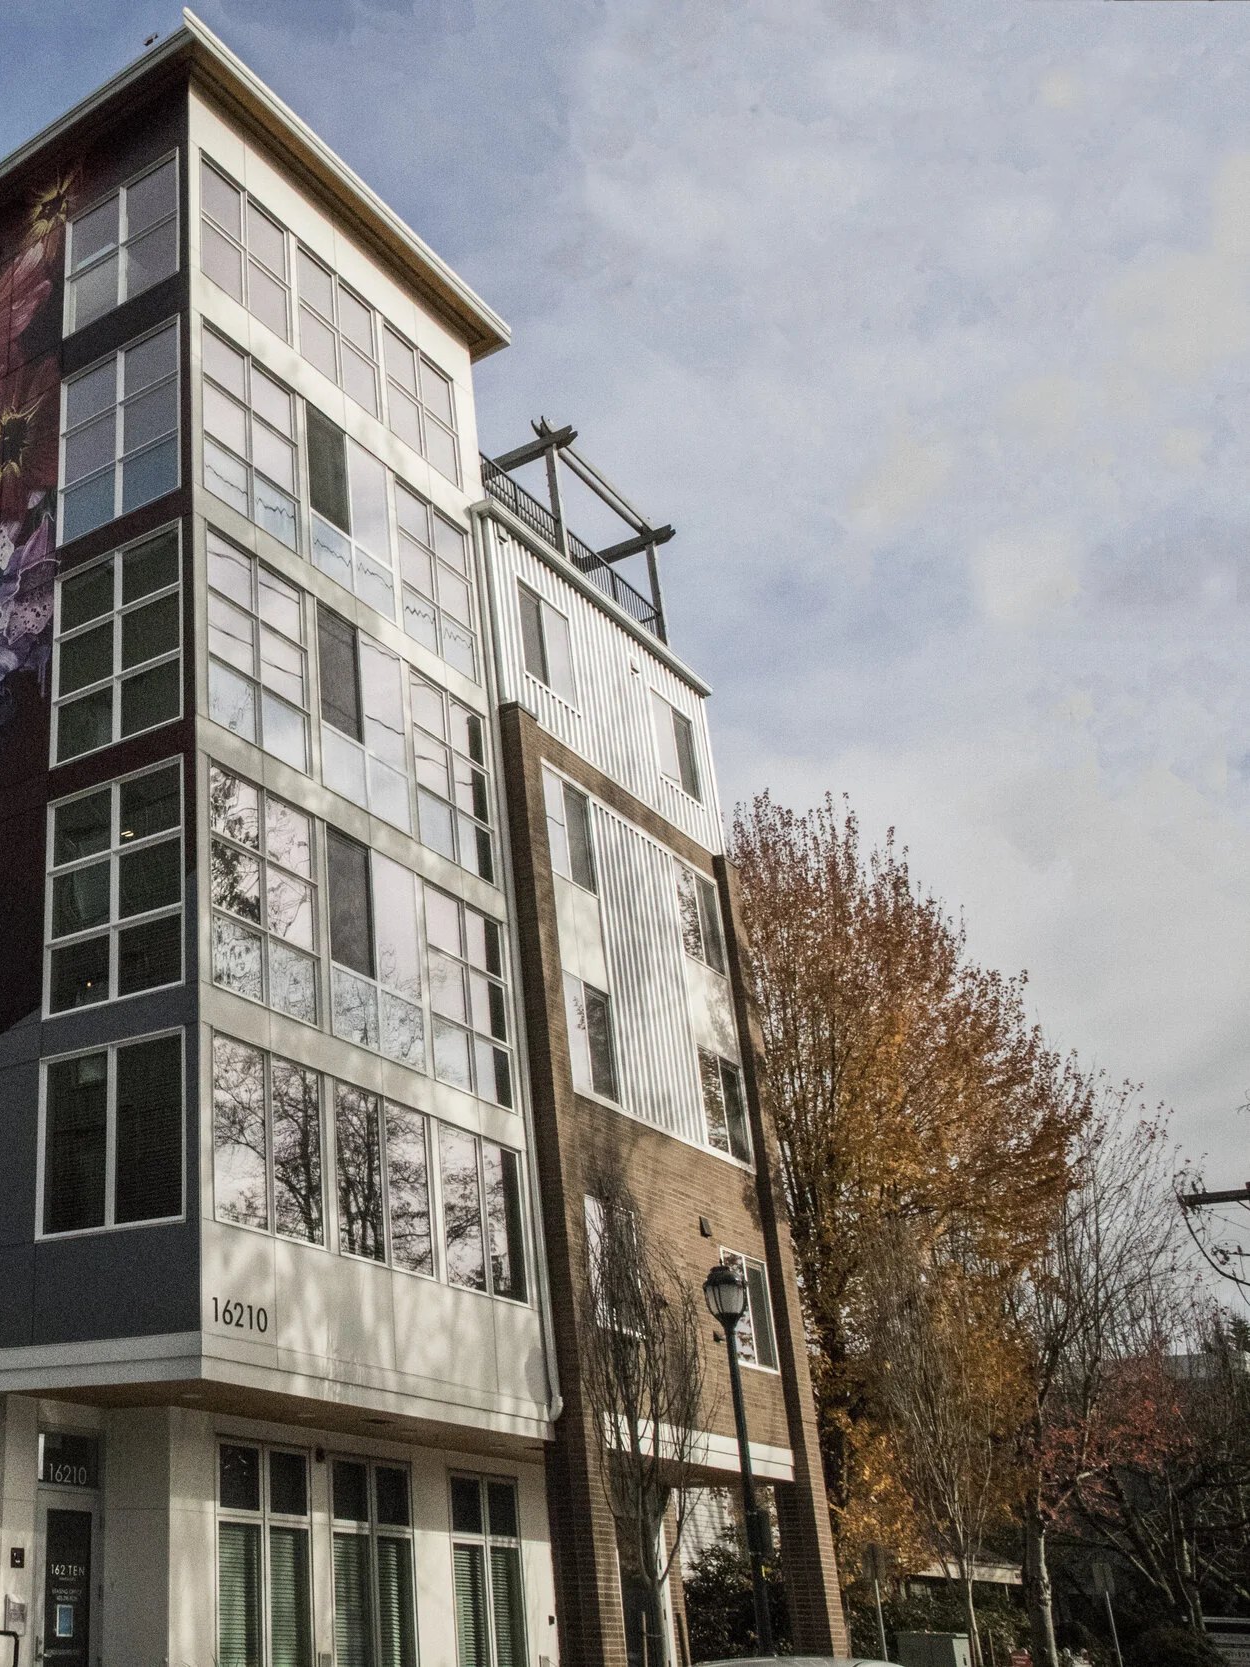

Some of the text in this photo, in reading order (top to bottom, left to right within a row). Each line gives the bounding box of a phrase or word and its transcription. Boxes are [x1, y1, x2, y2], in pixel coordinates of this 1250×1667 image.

[212, 1297, 268, 1333] 16210
[49, 1463, 87, 1485] 16210
[51, 1563, 85, 1576] 162 TEN
